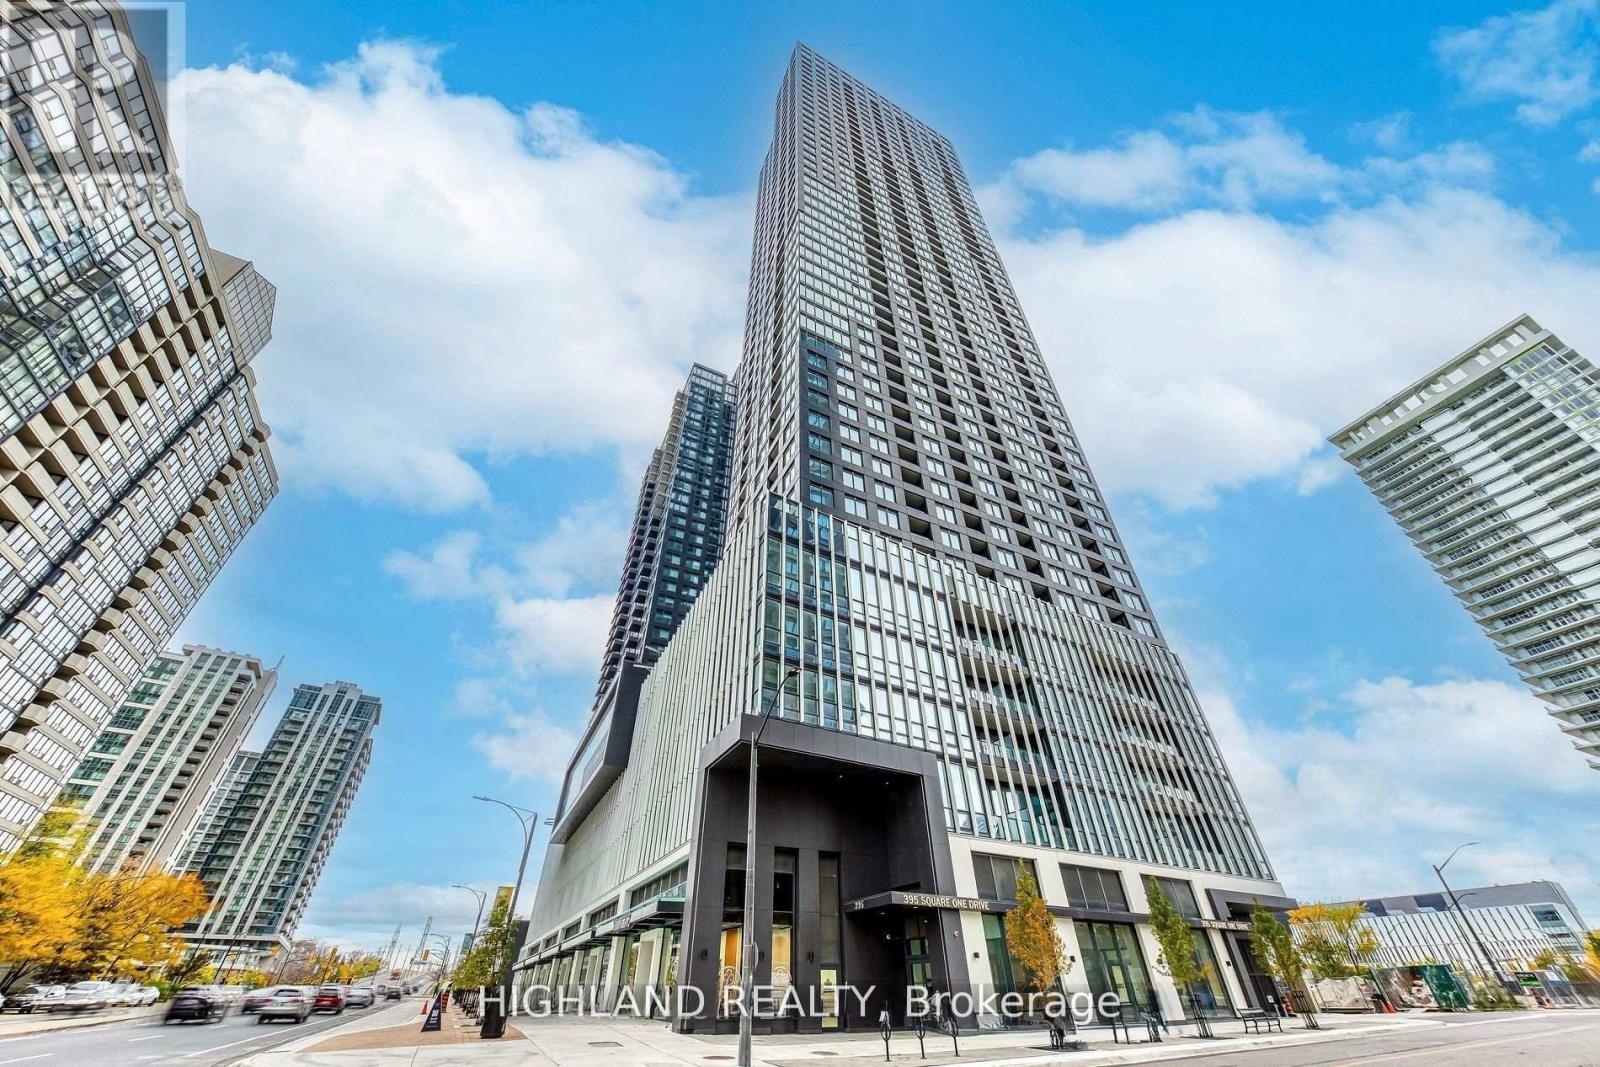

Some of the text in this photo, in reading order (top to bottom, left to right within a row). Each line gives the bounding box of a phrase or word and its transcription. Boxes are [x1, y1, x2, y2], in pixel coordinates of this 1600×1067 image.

[903, 894, 990, 910] 395 SQUARE ONE DRIVE
